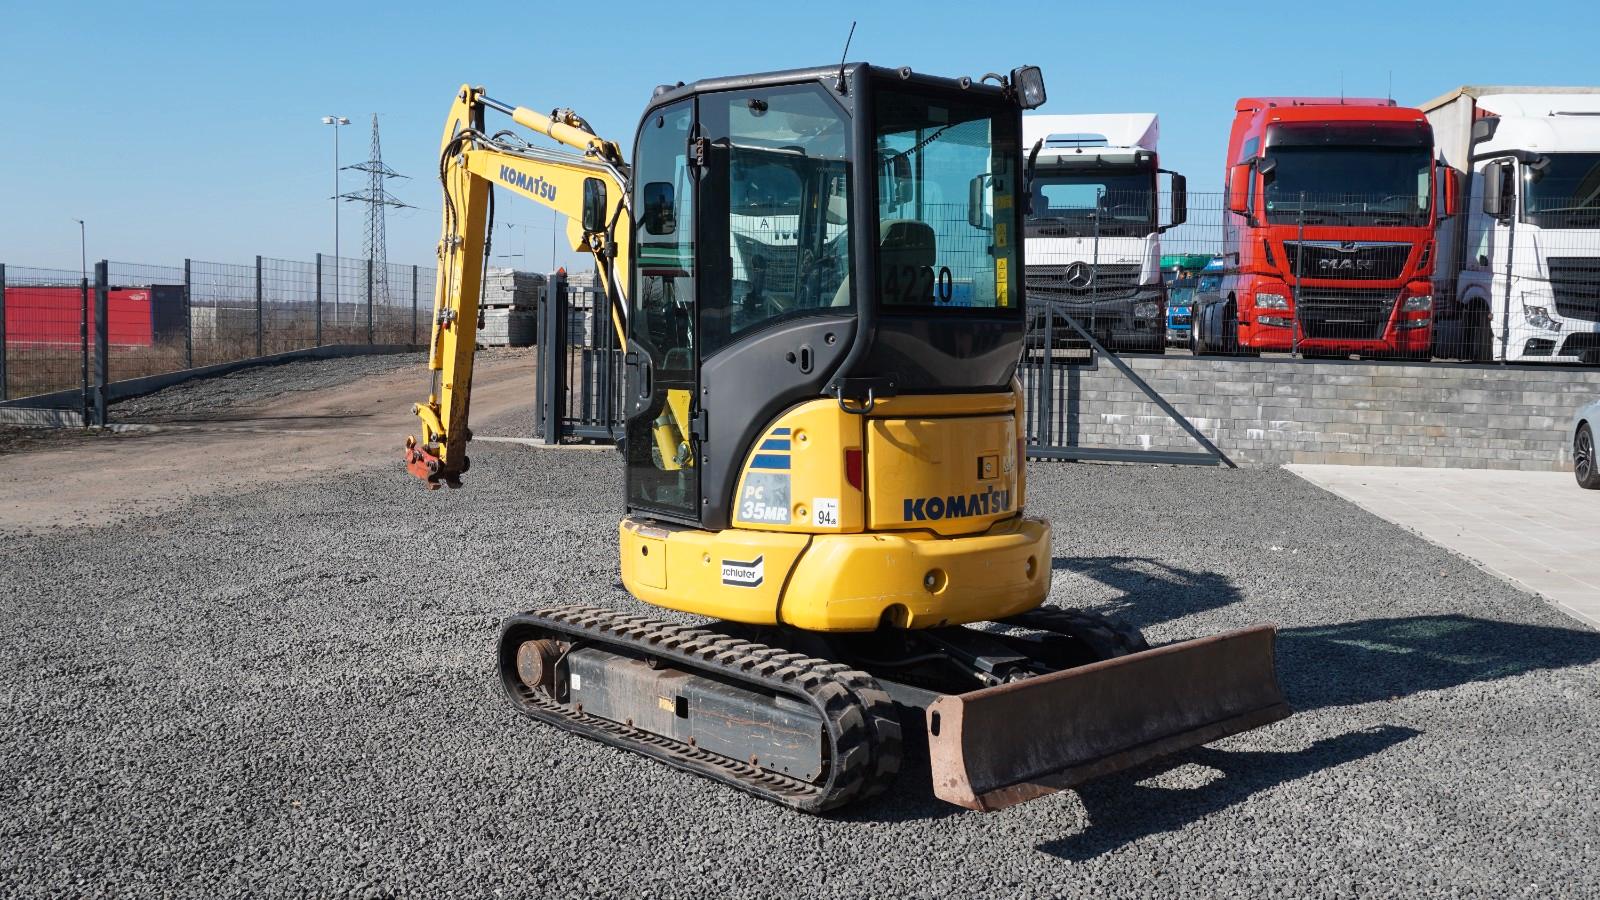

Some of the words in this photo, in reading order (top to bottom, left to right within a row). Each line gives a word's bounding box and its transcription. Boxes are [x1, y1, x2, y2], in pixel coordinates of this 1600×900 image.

[500, 164, 557, 202] KOMATSU
[884, 265, 953, 303] 4220
[745, 485, 764, 500] PC
[903, 486, 1010, 521] KOMATSU
[742, 501, 788, 521] 35MR
[818, 510, 830, 525] 94
